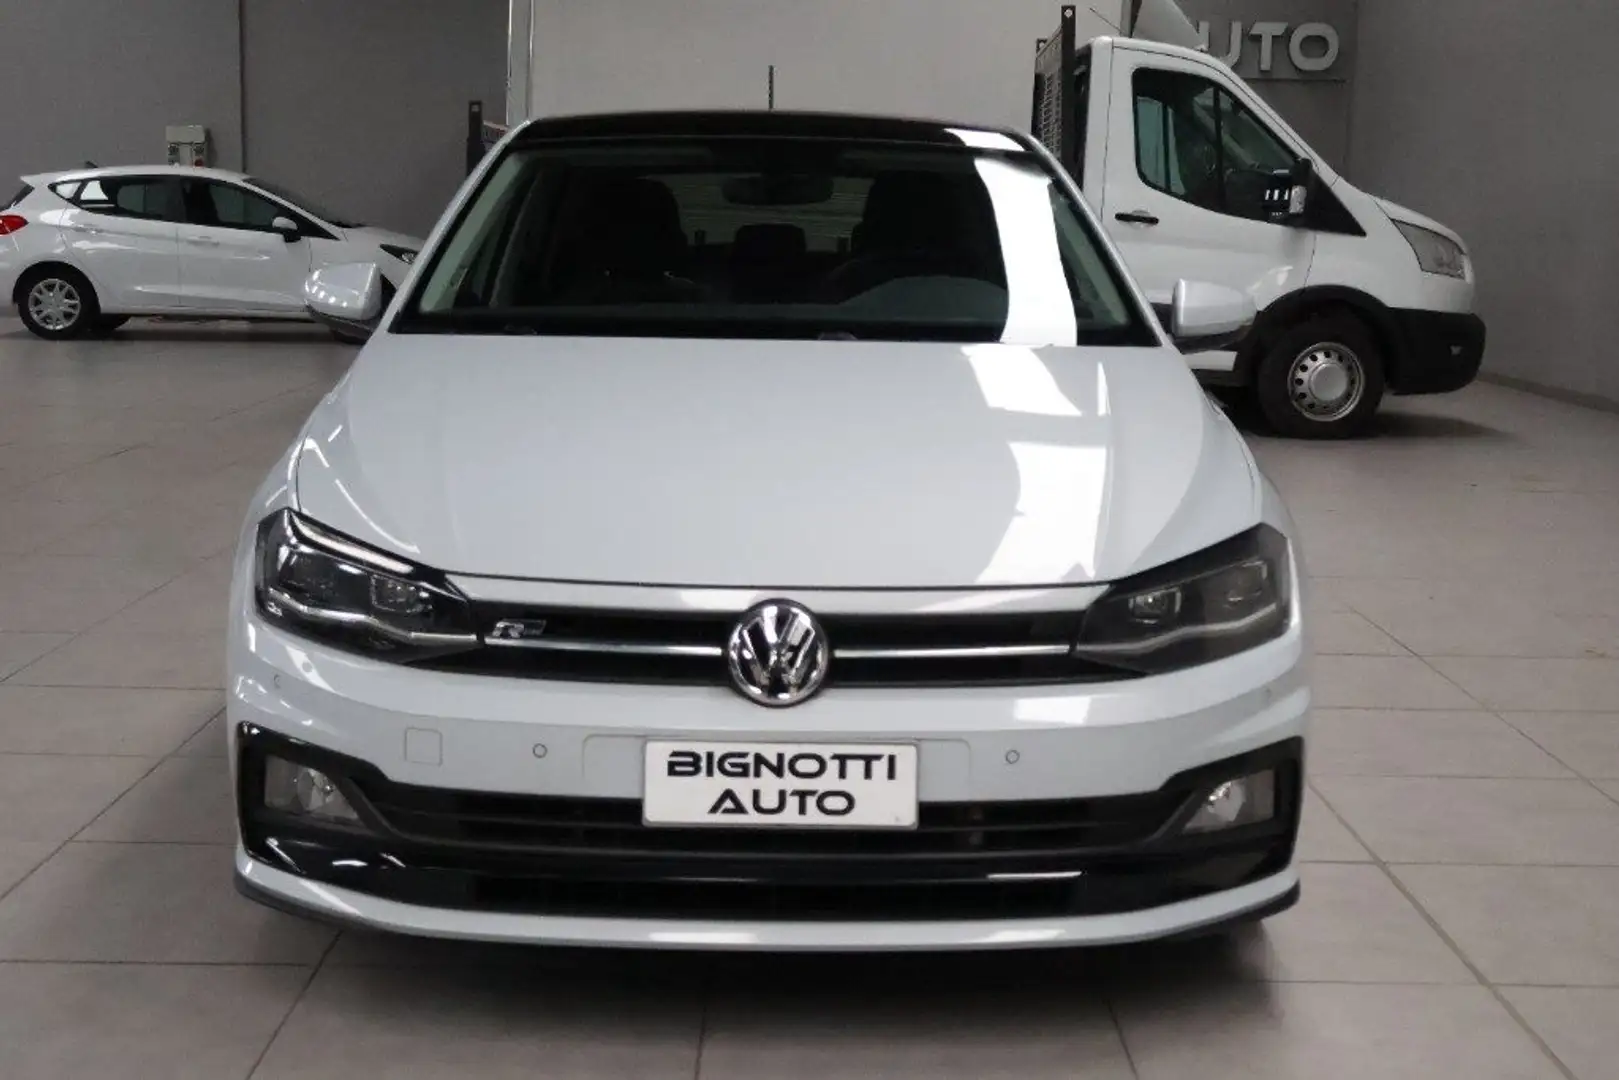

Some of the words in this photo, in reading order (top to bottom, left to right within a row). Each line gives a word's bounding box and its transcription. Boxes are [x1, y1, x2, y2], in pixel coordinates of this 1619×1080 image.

[1198, 21, 1340, 71] UTO
[667, 751, 896, 780] BIGNOTTI
[707, 788, 856, 816] AUTO
